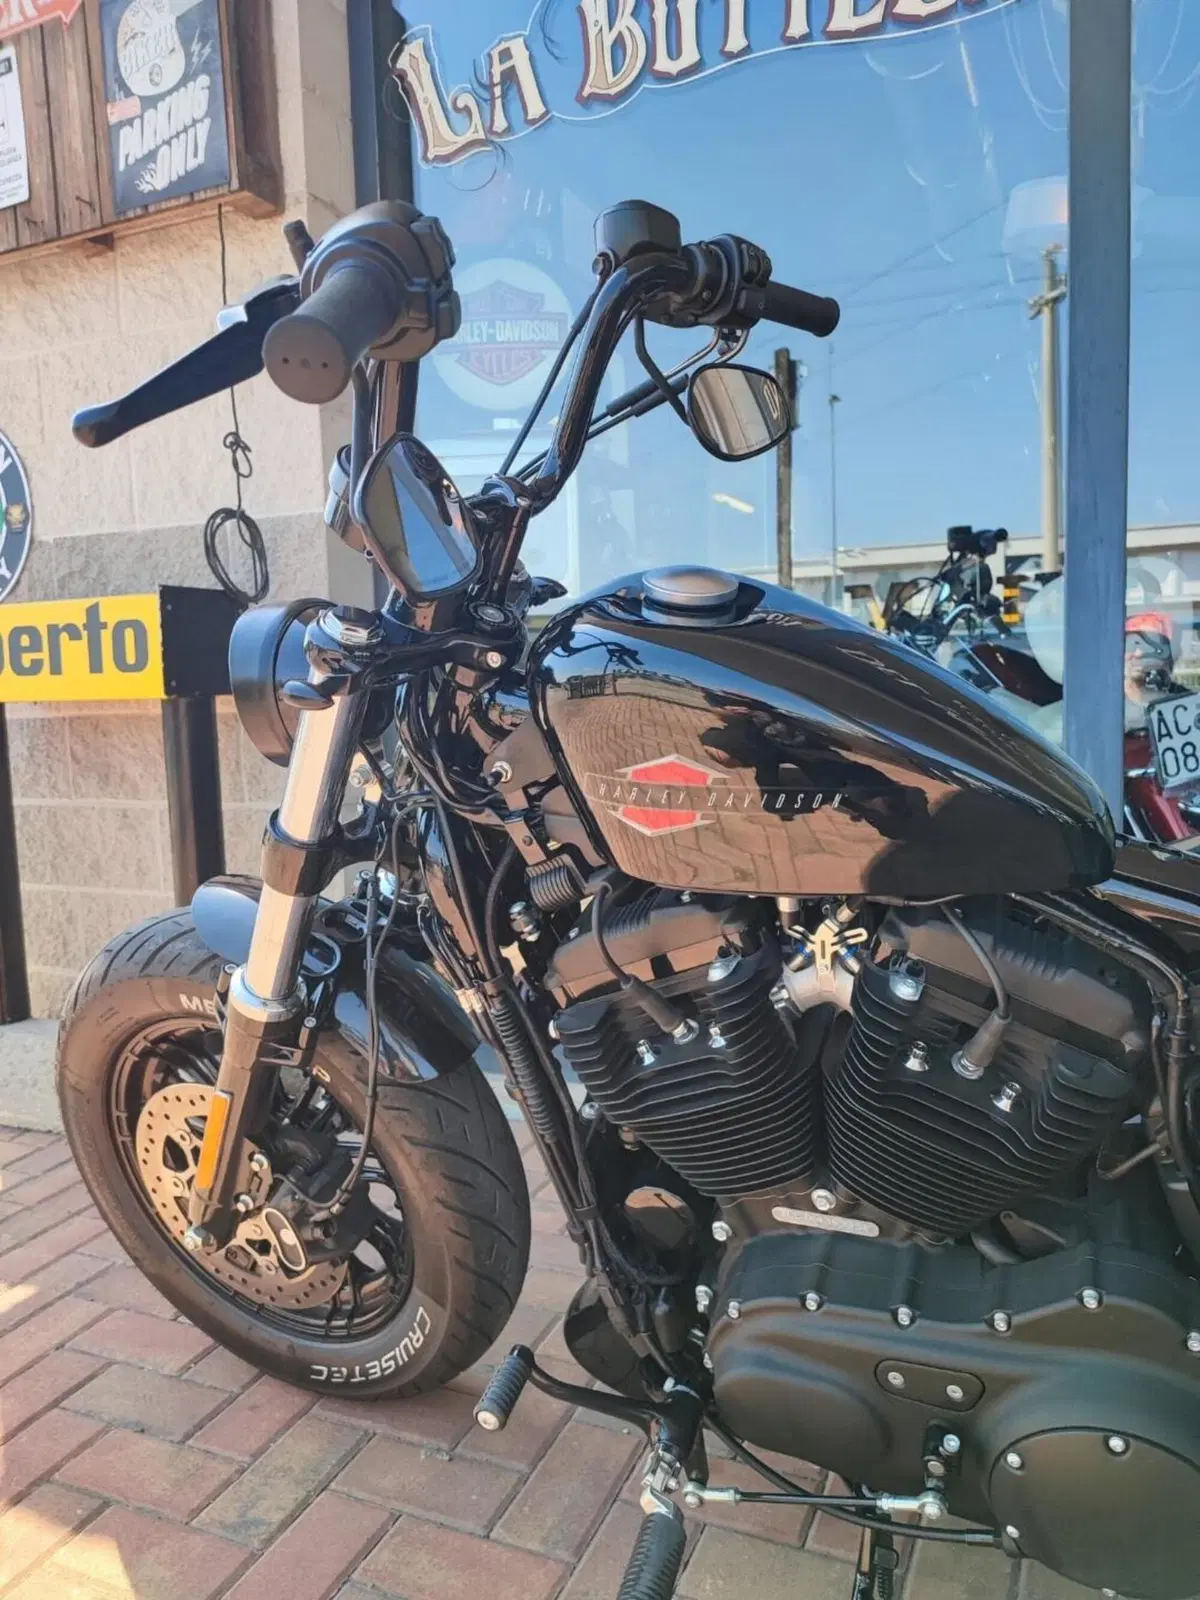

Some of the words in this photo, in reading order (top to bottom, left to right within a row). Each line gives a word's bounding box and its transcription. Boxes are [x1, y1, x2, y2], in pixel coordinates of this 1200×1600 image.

[118, 74, 211, 172] PARKING
[392, 35, 550, 163] LA
[149, 116, 212, 192] ONLY
[0, 602, 149, 676] erto
[1157, 704, 1192, 742] AC
[310, 1306, 431, 1382] CRUISETEC
